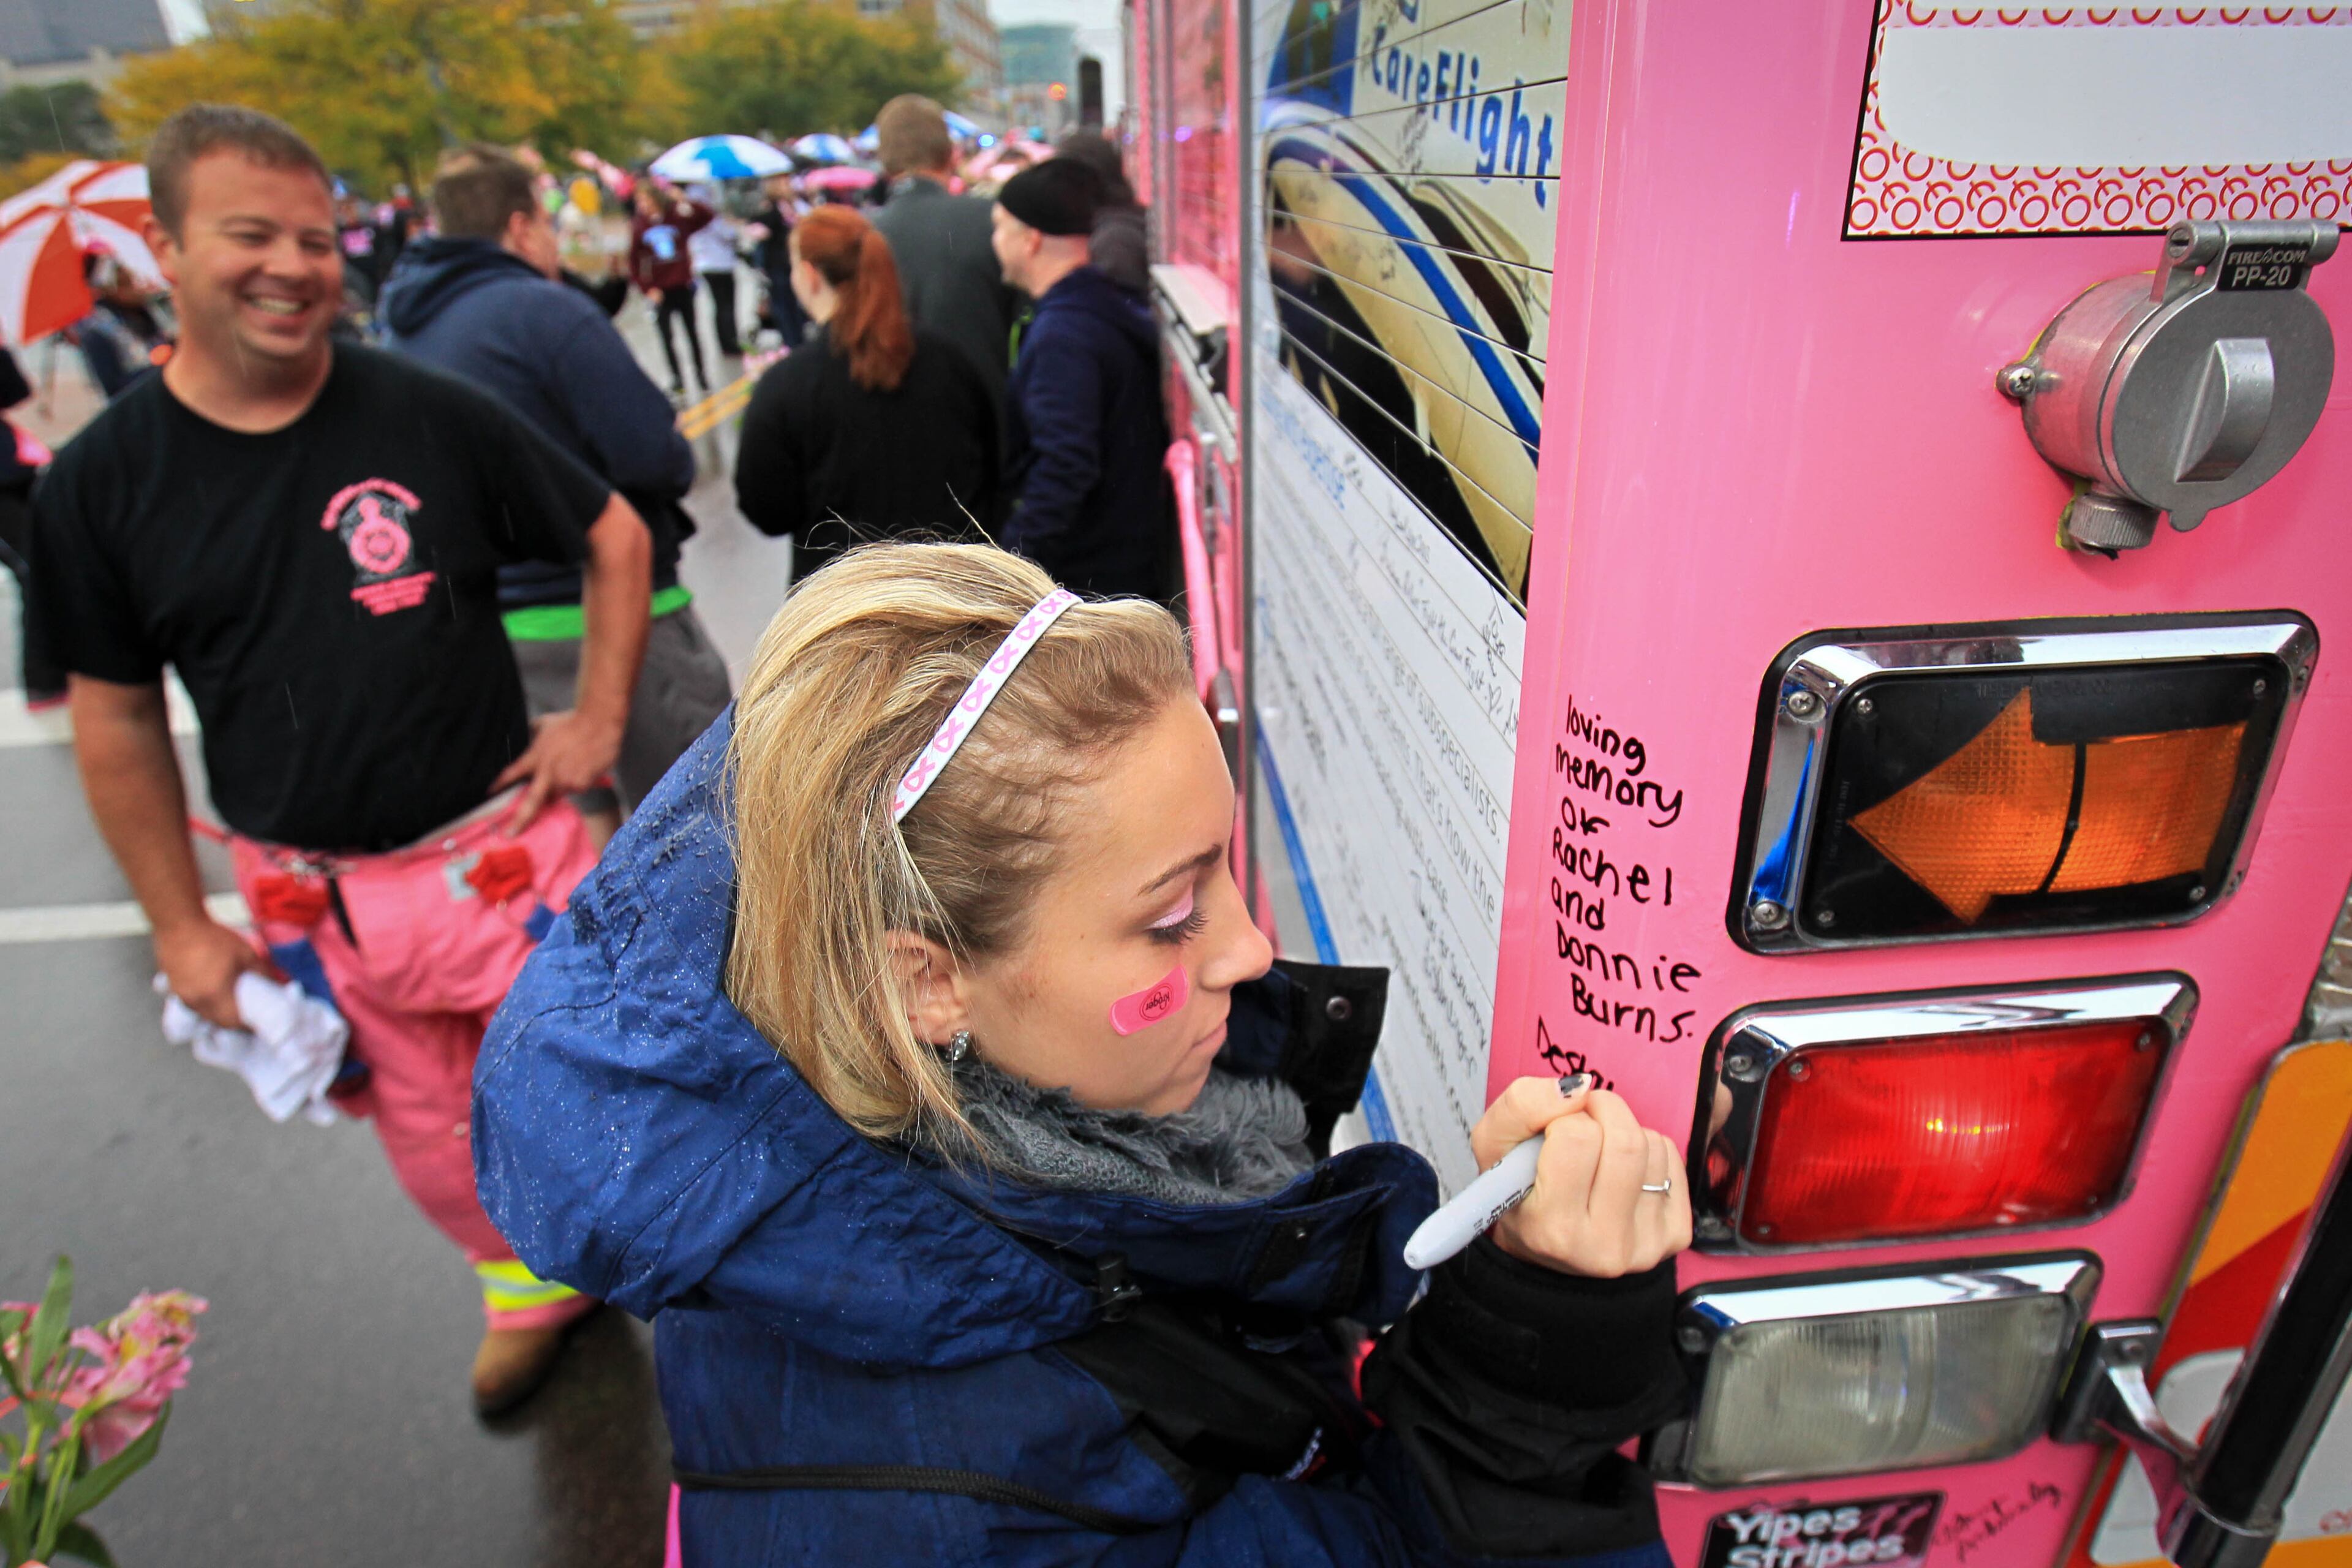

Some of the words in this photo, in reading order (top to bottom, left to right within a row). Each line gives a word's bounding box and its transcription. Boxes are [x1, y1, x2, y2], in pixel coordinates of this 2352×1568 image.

[1372, 23, 1553, 209] CareFlight
[2227, 250, 2265, 265] FIRE
[2273, 249, 2307, 263] COM
[2231, 265, 2291, 288] PP-20
[1419, 692, 1500, 844] subspecialists.
[1447, 806, 1471, 875] how
[1474, 859, 1495, 923] the
[1552, 827, 1672, 906] Rachel
[1727, 1506, 1862, 1548] Yipes
